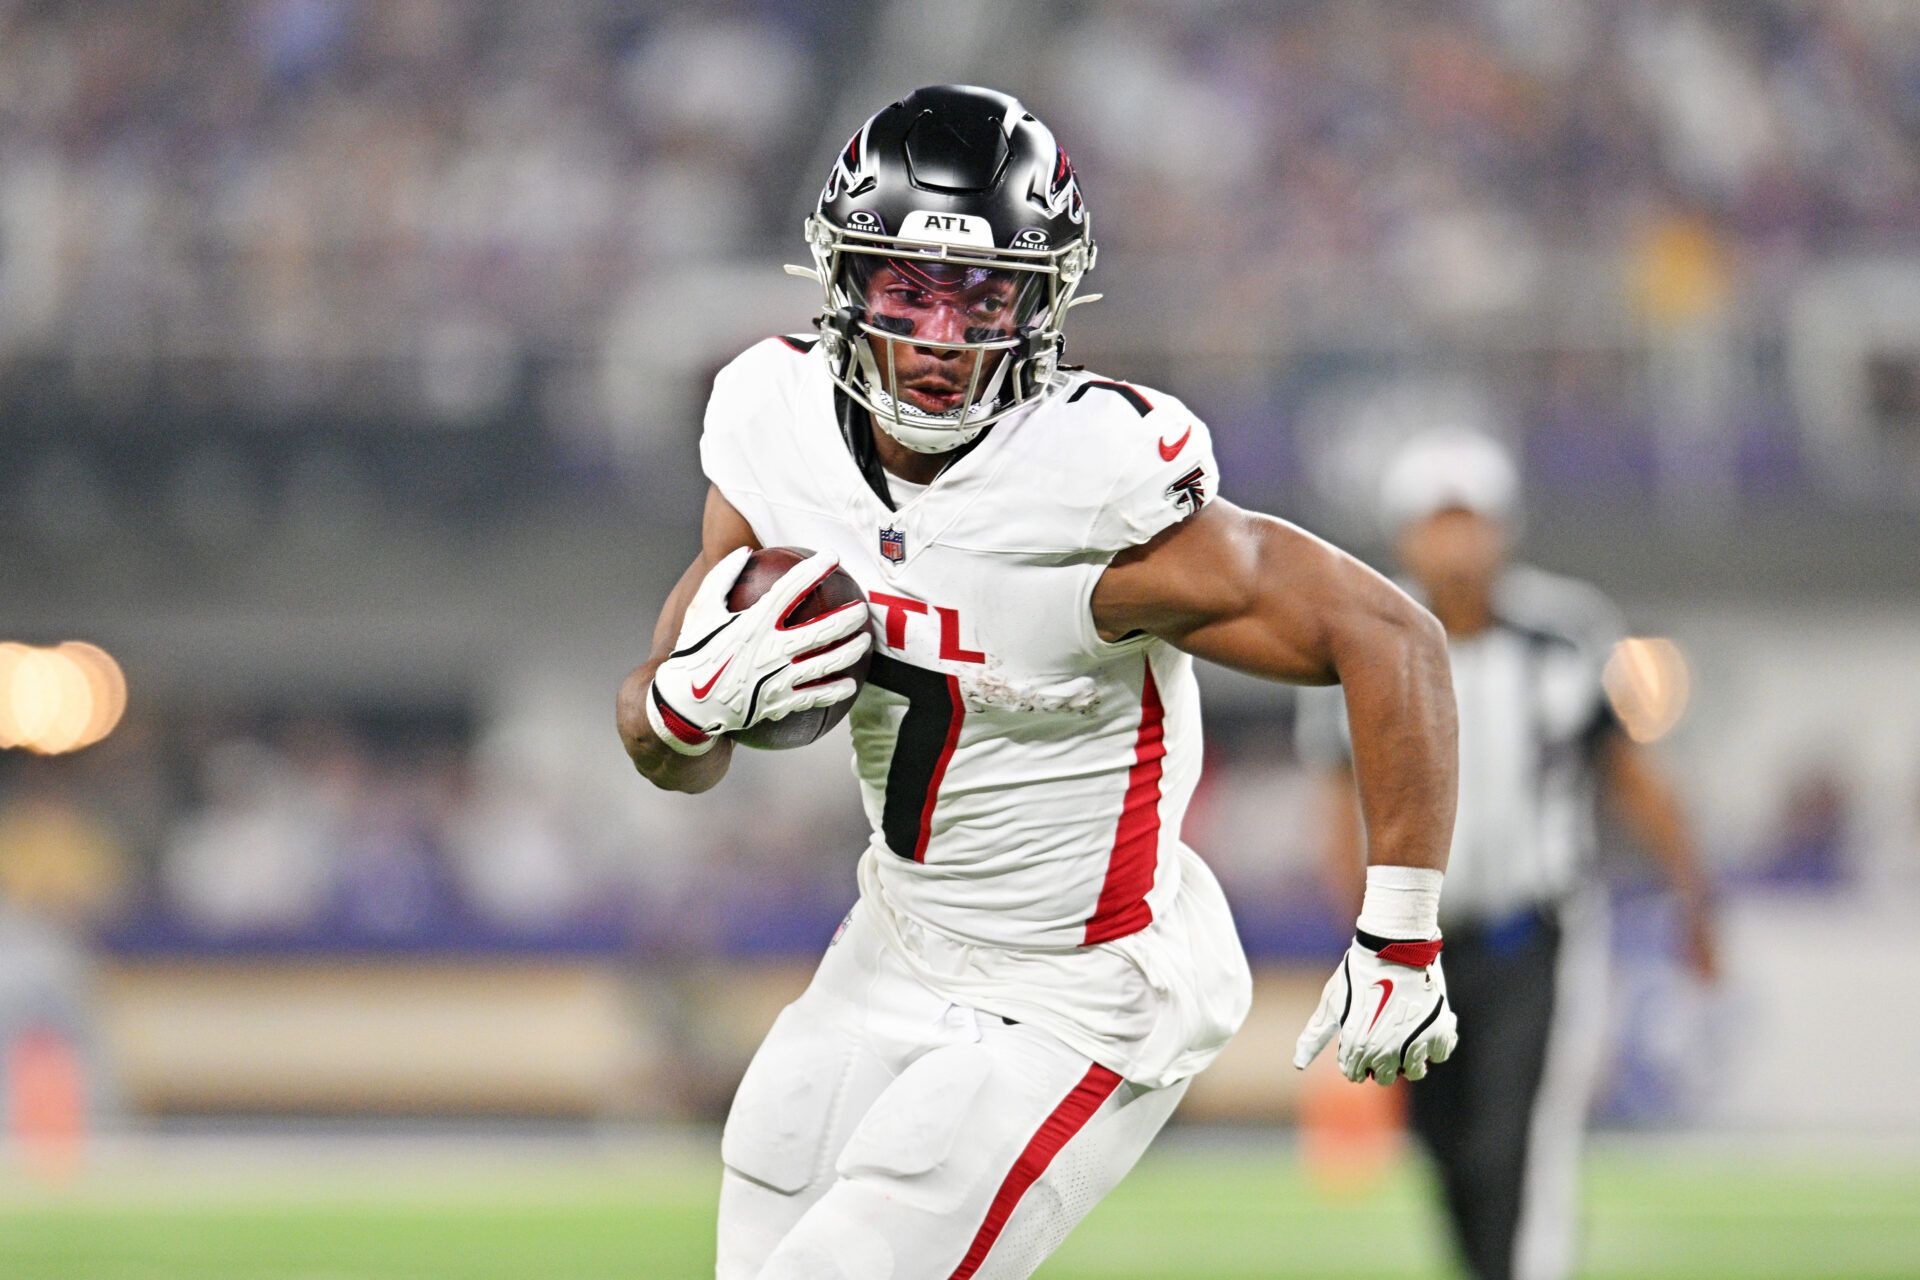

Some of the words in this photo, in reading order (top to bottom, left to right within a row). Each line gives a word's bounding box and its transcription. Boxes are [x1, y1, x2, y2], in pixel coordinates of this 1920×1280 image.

[846, 222, 881, 232] OAKLEY
[924, 215, 971, 233] ATL
[1015, 240, 1049, 251] OAKLEY
[867, 590, 986, 664] TL
[865, 652, 966, 864] 7
